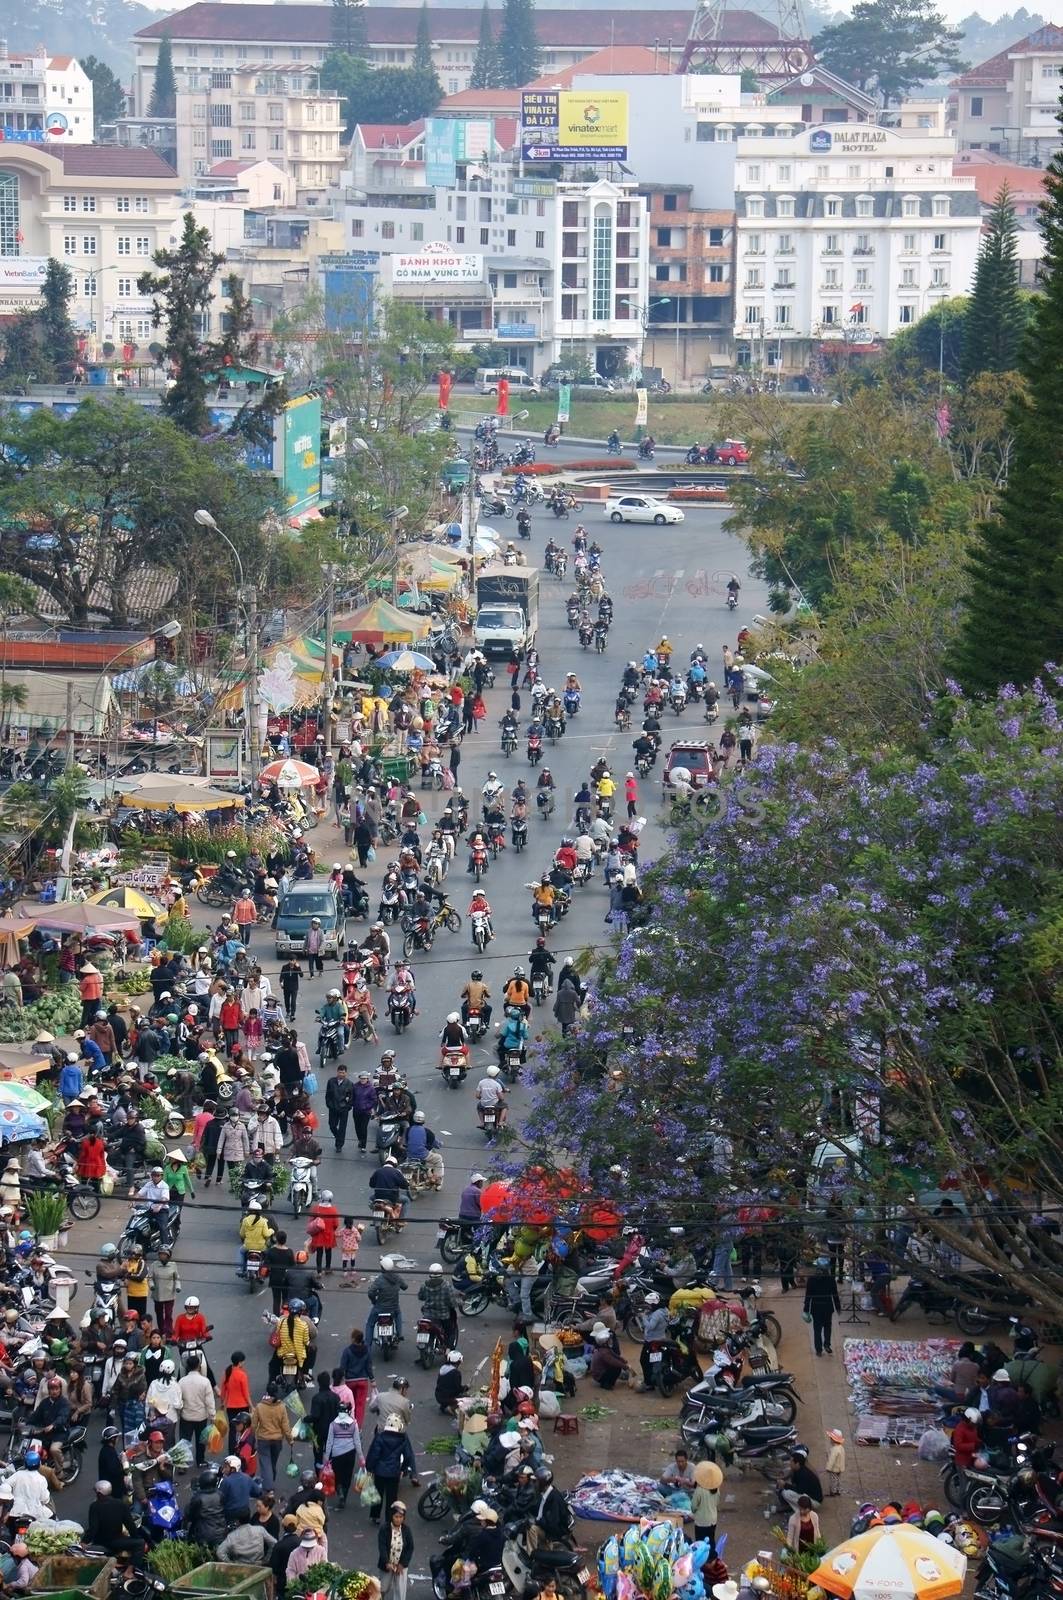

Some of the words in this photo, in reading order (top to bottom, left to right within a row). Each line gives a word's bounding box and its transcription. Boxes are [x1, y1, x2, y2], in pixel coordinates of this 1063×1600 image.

[523, 94, 543, 104] SIÊU
[523, 106, 557, 115] VINATEX
[526, 115, 537, 125] ĐÀ
[539, 117, 554, 127] LẠT
[568, 124, 618, 133] vinatexmart
[834, 132, 861, 143] DALAT
[862, 132, 887, 143] PLAZA
[534, 149, 549, 157] 3km
[400, 257, 430, 266] BÁNH
[4, 269, 38, 278] VietinBank
[146, 875, 157, 883] XE
